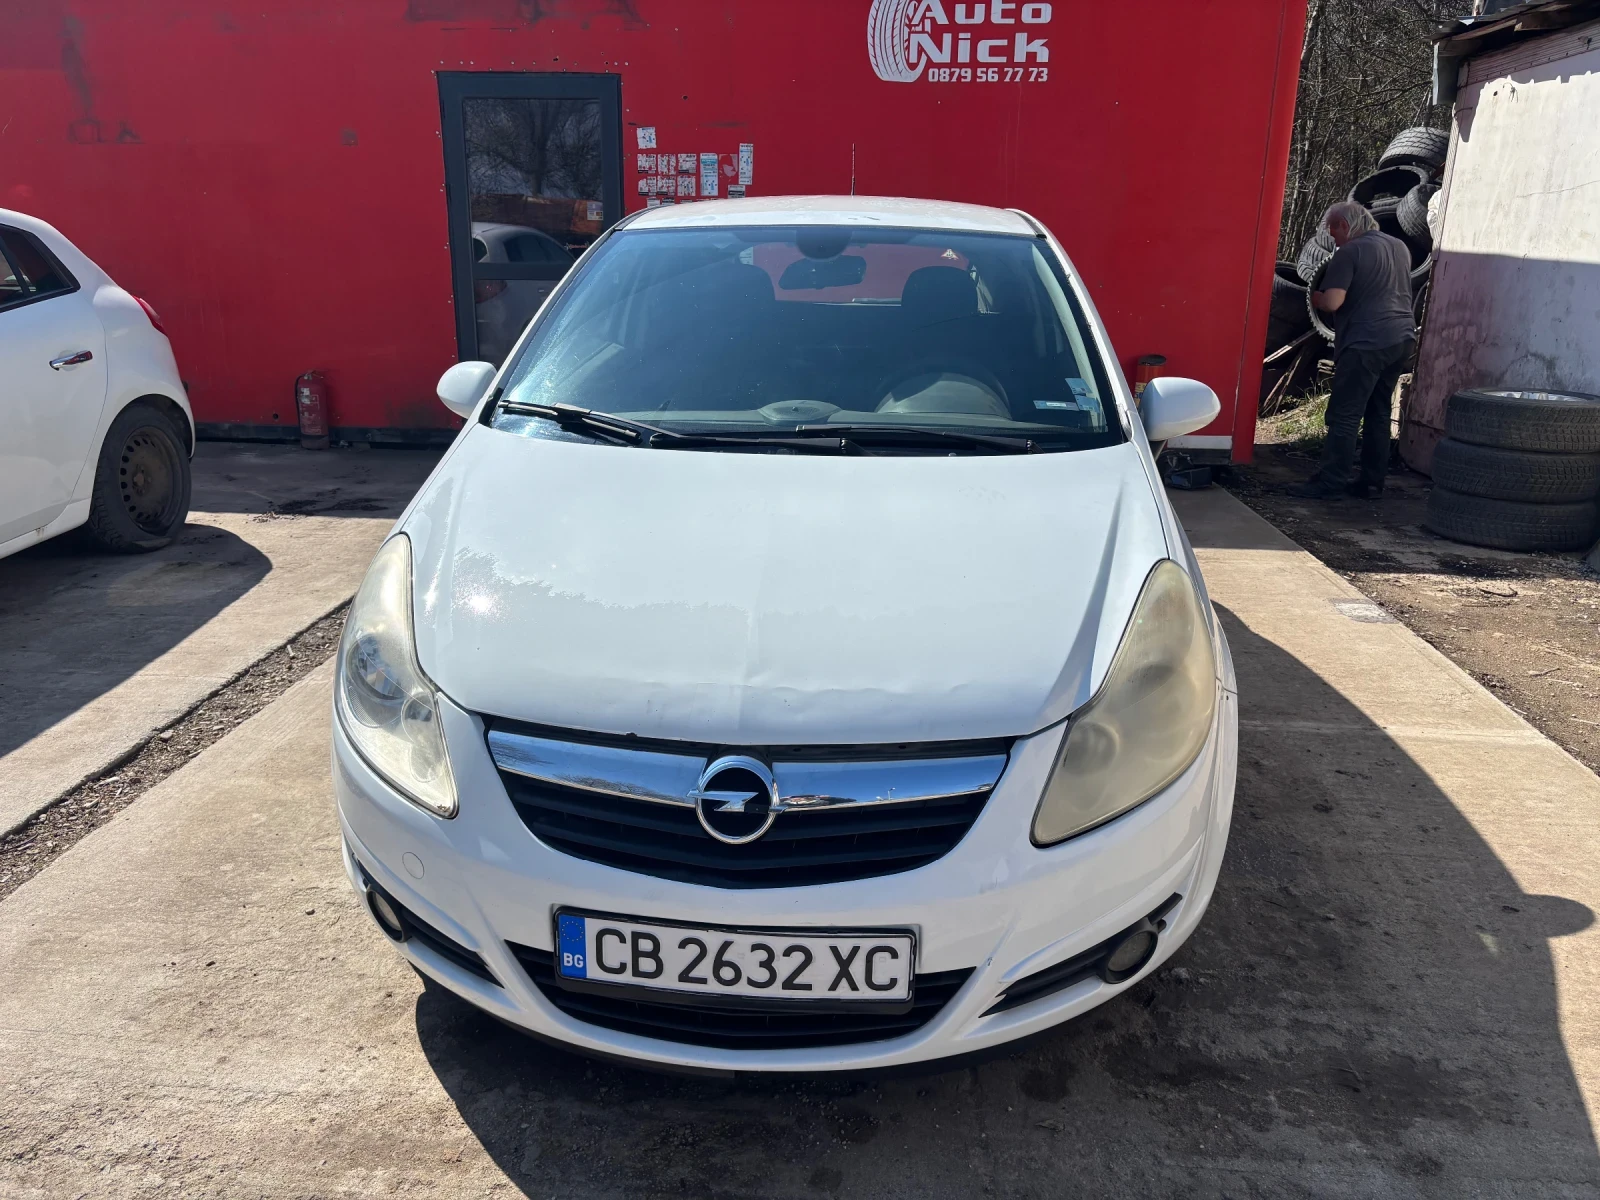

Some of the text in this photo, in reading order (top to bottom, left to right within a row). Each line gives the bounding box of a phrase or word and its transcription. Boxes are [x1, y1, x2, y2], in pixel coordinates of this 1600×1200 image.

[911, 0, 1052, 25] Auto
[909, 33, 1049, 63] Nick
[928, 68, 1048, 82] 0879 56 77 73
[563, 952, 584, 969] BG
[595, 928, 899, 992] CB 2632 XC
